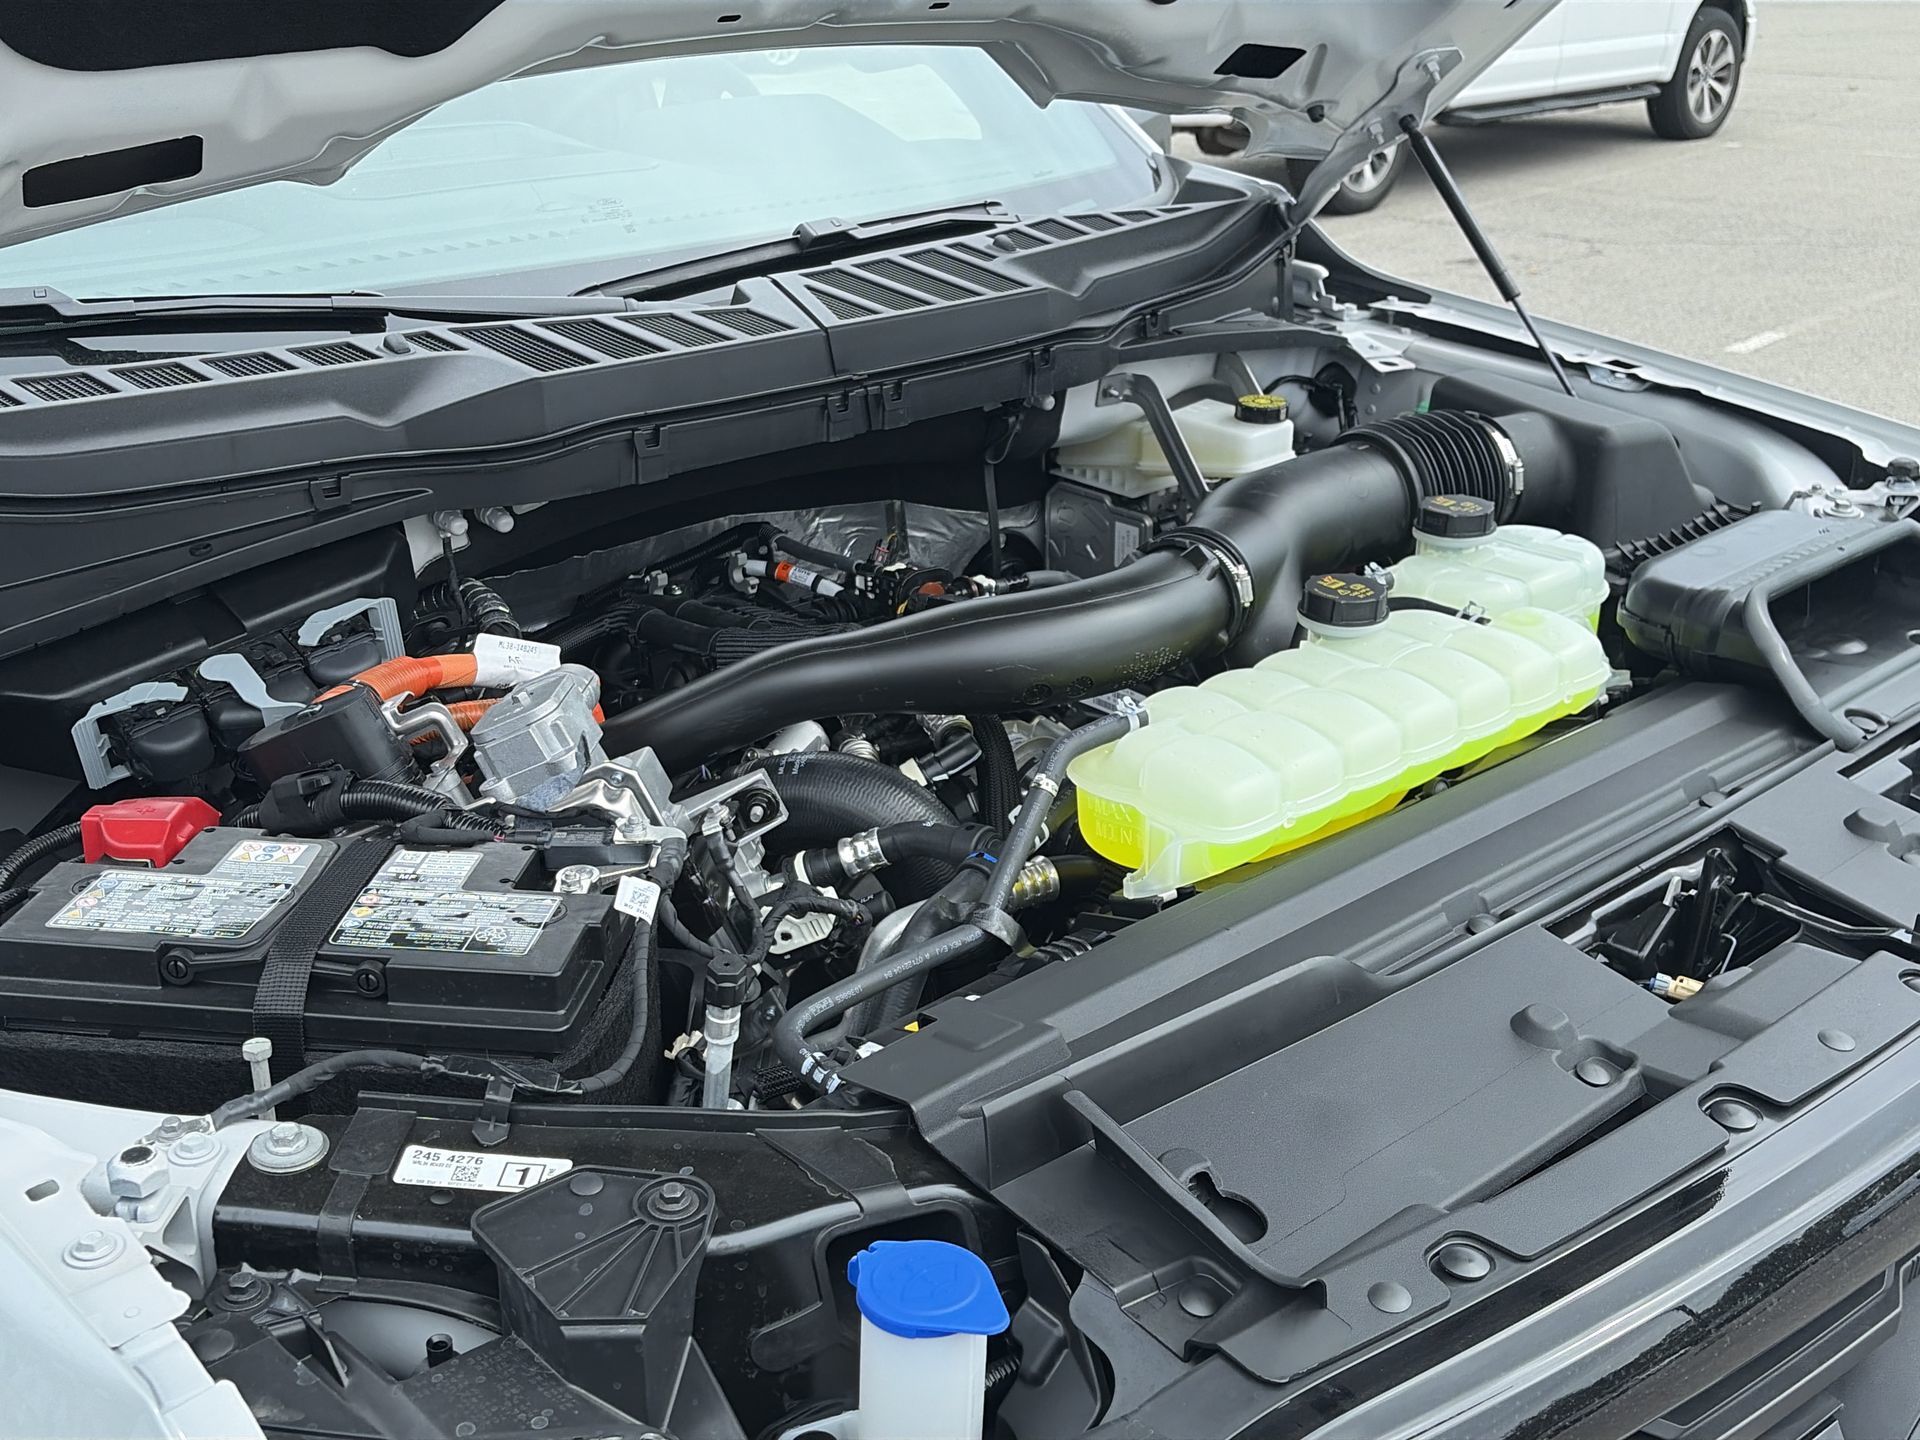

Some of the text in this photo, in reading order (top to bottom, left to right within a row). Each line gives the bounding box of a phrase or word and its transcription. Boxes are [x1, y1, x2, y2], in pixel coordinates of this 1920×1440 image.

[1095, 821, 1134, 844] MIN
[412, 1149, 441, 1162] 245
[446, 1154, 485, 1166] 4276
[515, 1167, 531, 1186] 1
